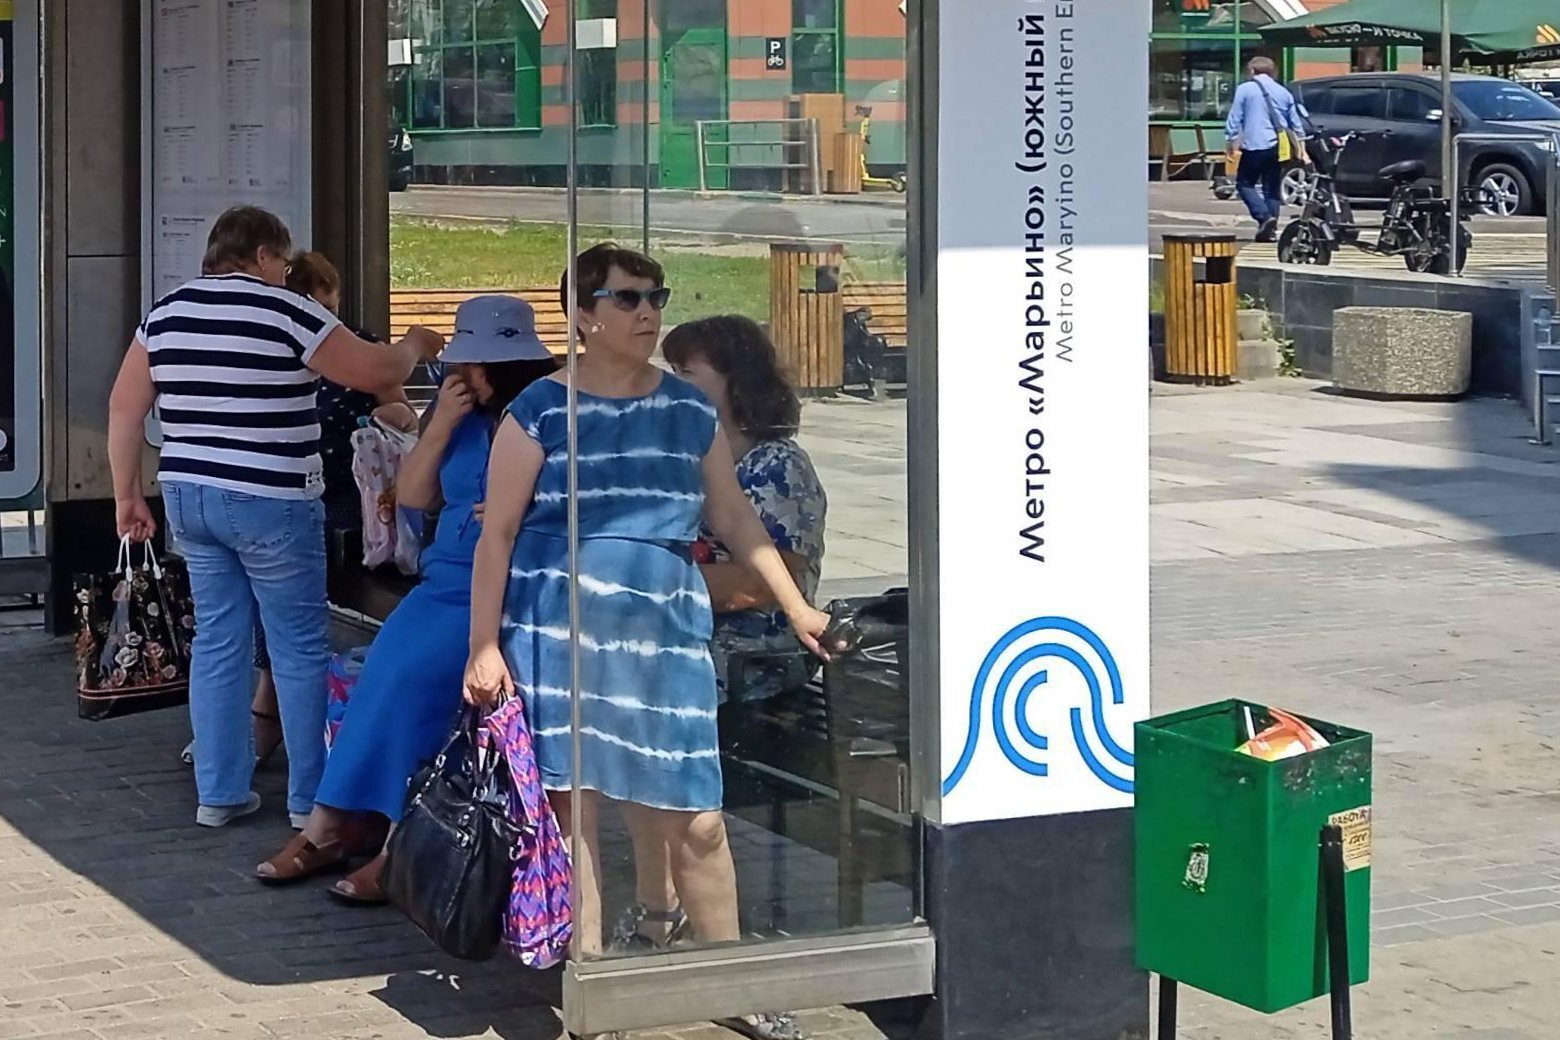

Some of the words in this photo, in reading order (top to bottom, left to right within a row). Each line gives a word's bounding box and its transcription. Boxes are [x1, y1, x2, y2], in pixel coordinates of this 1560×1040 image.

[770, 41, 781, 54] P
[1015, 14, 1048, 174] (южный
[1053, 27, 1076, 155] (Southern
[1055, 163, 1077, 275] Maryino
[1018, 184, 1051, 417] «Марьино»
[1055, 282, 1074, 363] Metro
[1018, 428, 1050, 564] Метро
